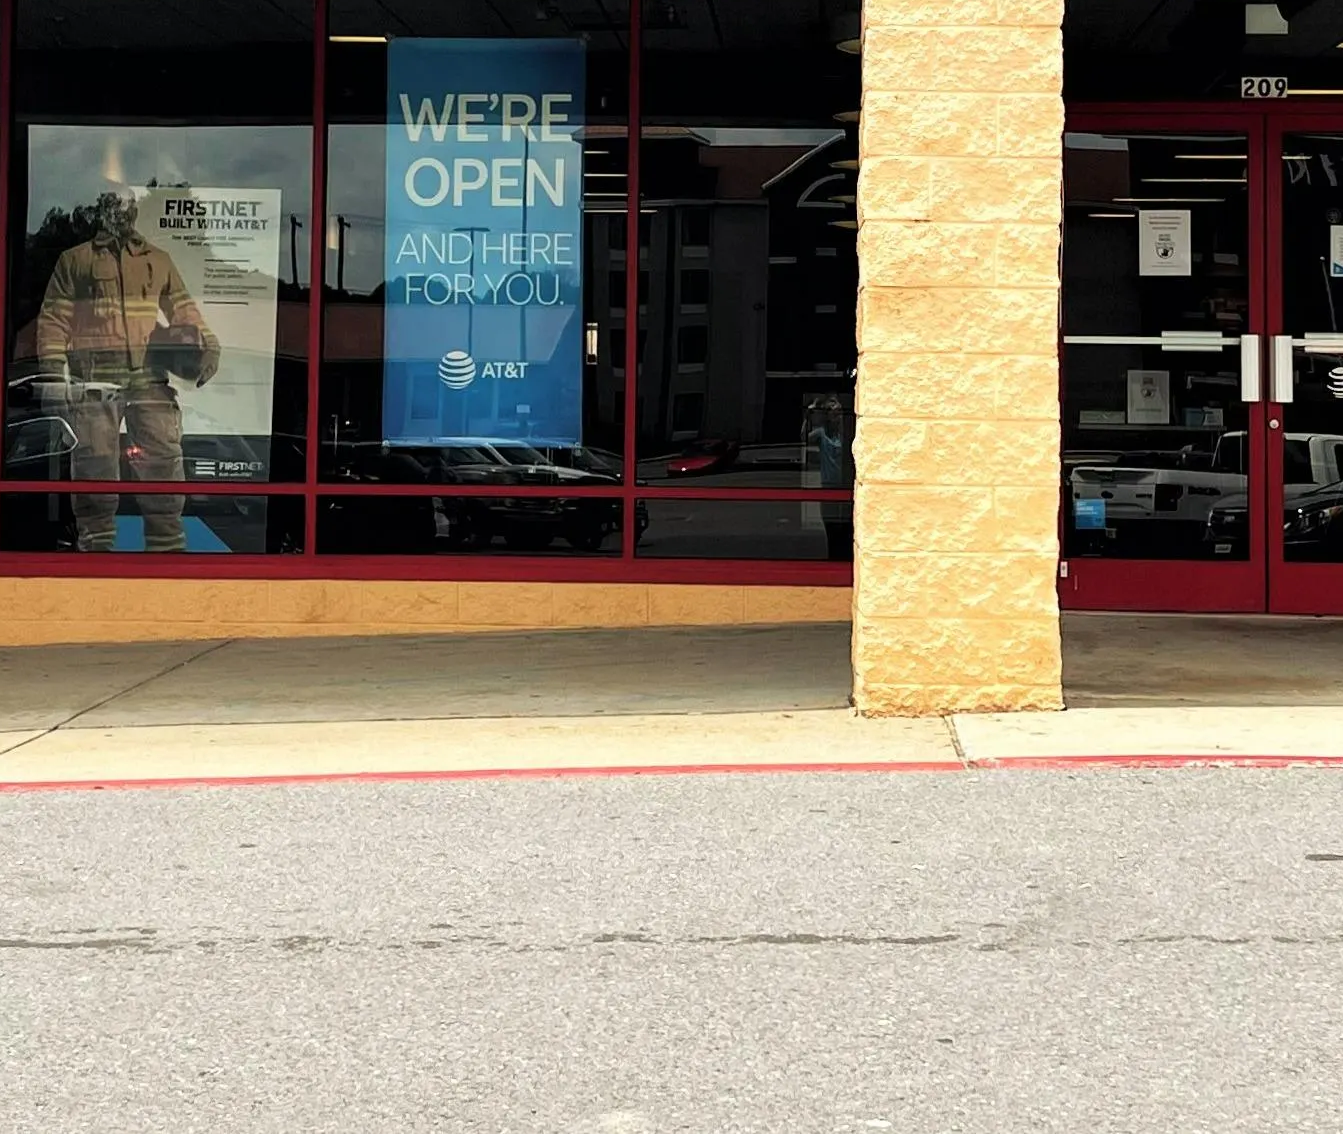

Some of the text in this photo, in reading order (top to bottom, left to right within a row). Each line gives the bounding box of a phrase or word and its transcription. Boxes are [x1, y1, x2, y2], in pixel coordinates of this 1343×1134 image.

[1243, 78, 1287, 97] 209
[399, 93, 573, 143] WE'RE
[404, 157, 565, 207] OPEN
[164, 199, 263, 217] FIRSTNET
[159, 217, 269, 231] BUILT WITH AT&T
[395, 232, 574, 265] AND HERE
[405, 272, 565, 306] FOR YOU.
[481, 362, 529, 379] AT&T
[218, 461, 264, 471] FIRSTNET
